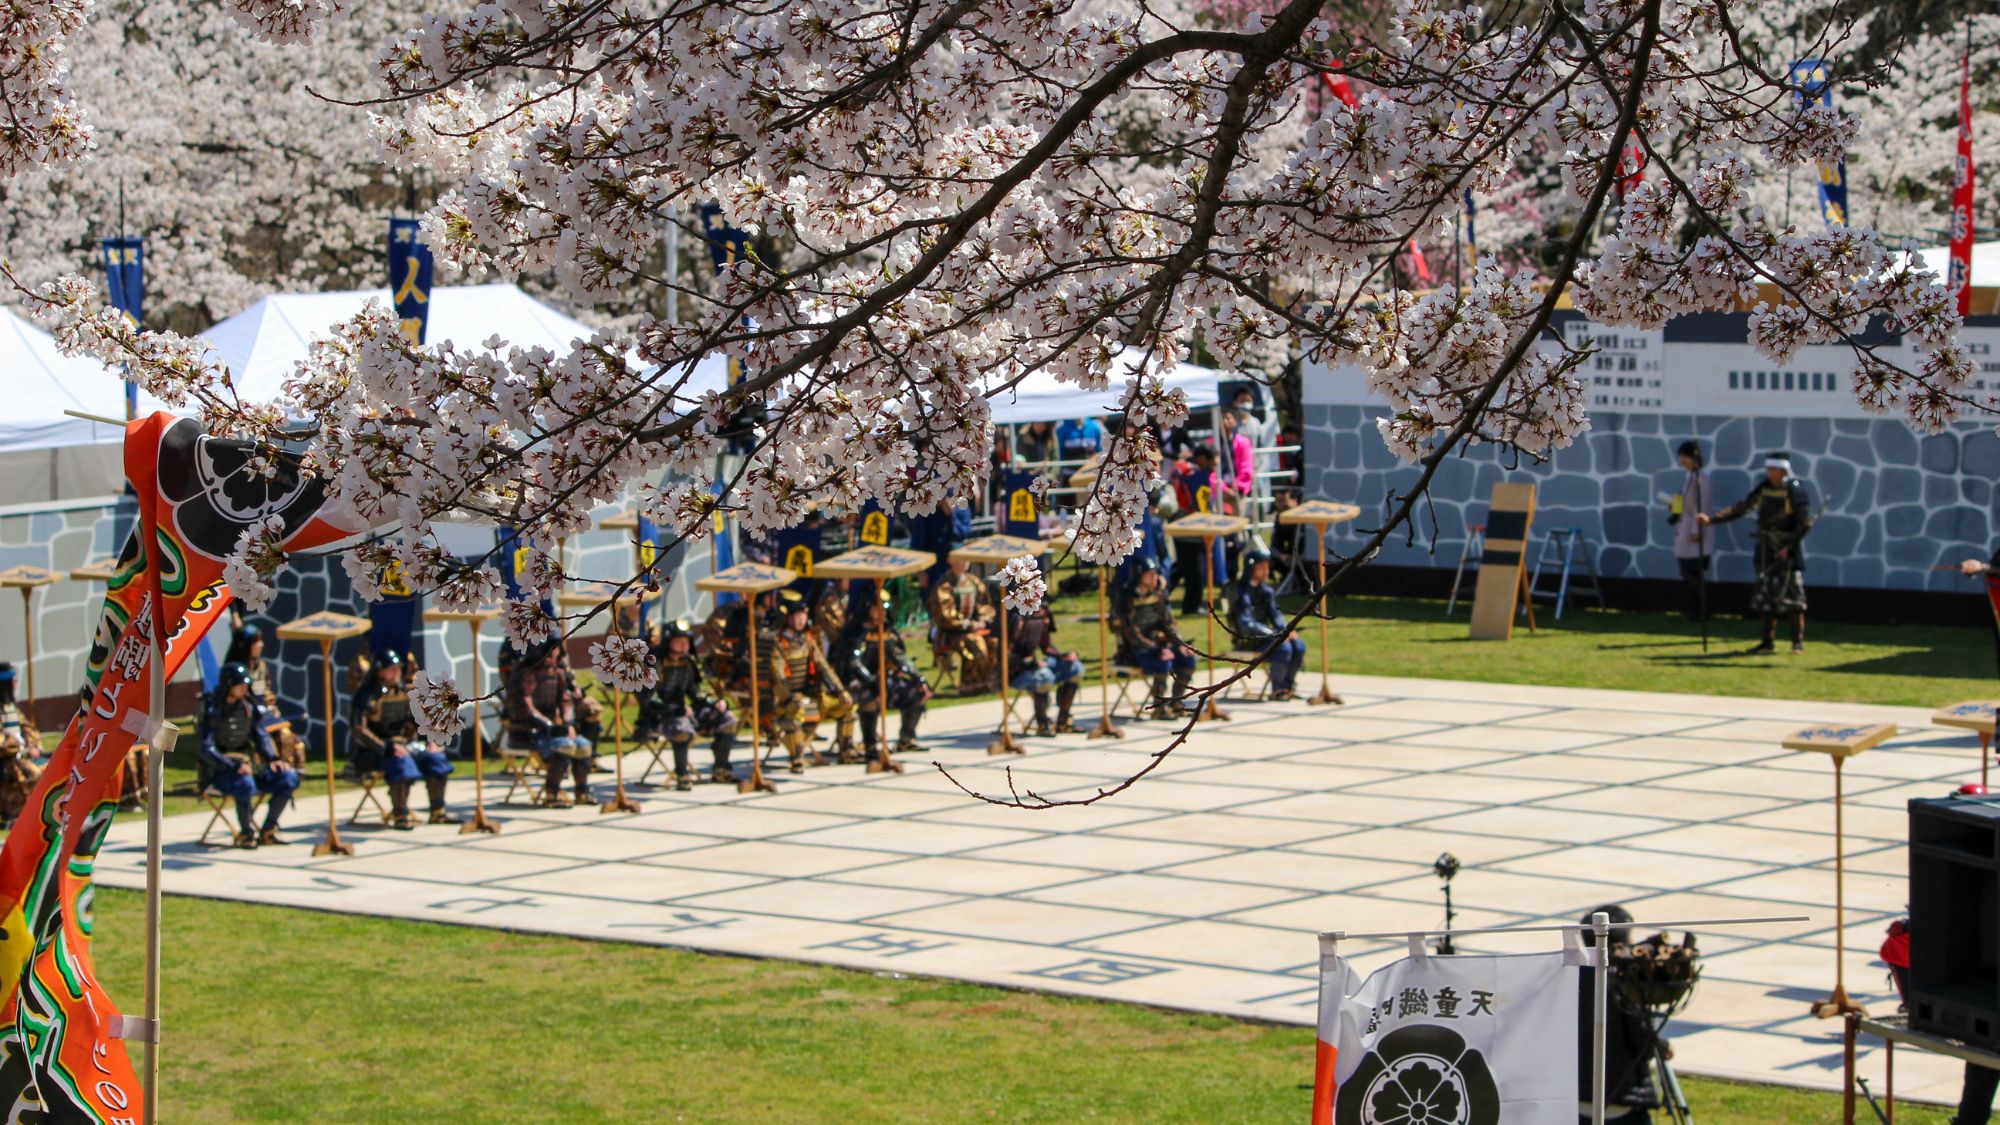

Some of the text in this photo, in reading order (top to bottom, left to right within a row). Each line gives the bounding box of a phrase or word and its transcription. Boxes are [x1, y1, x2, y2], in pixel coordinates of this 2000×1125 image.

[606, 912, 745, 934] 六
[803, 932, 957, 957] 五
[1011, 957, 1179, 986] 四
